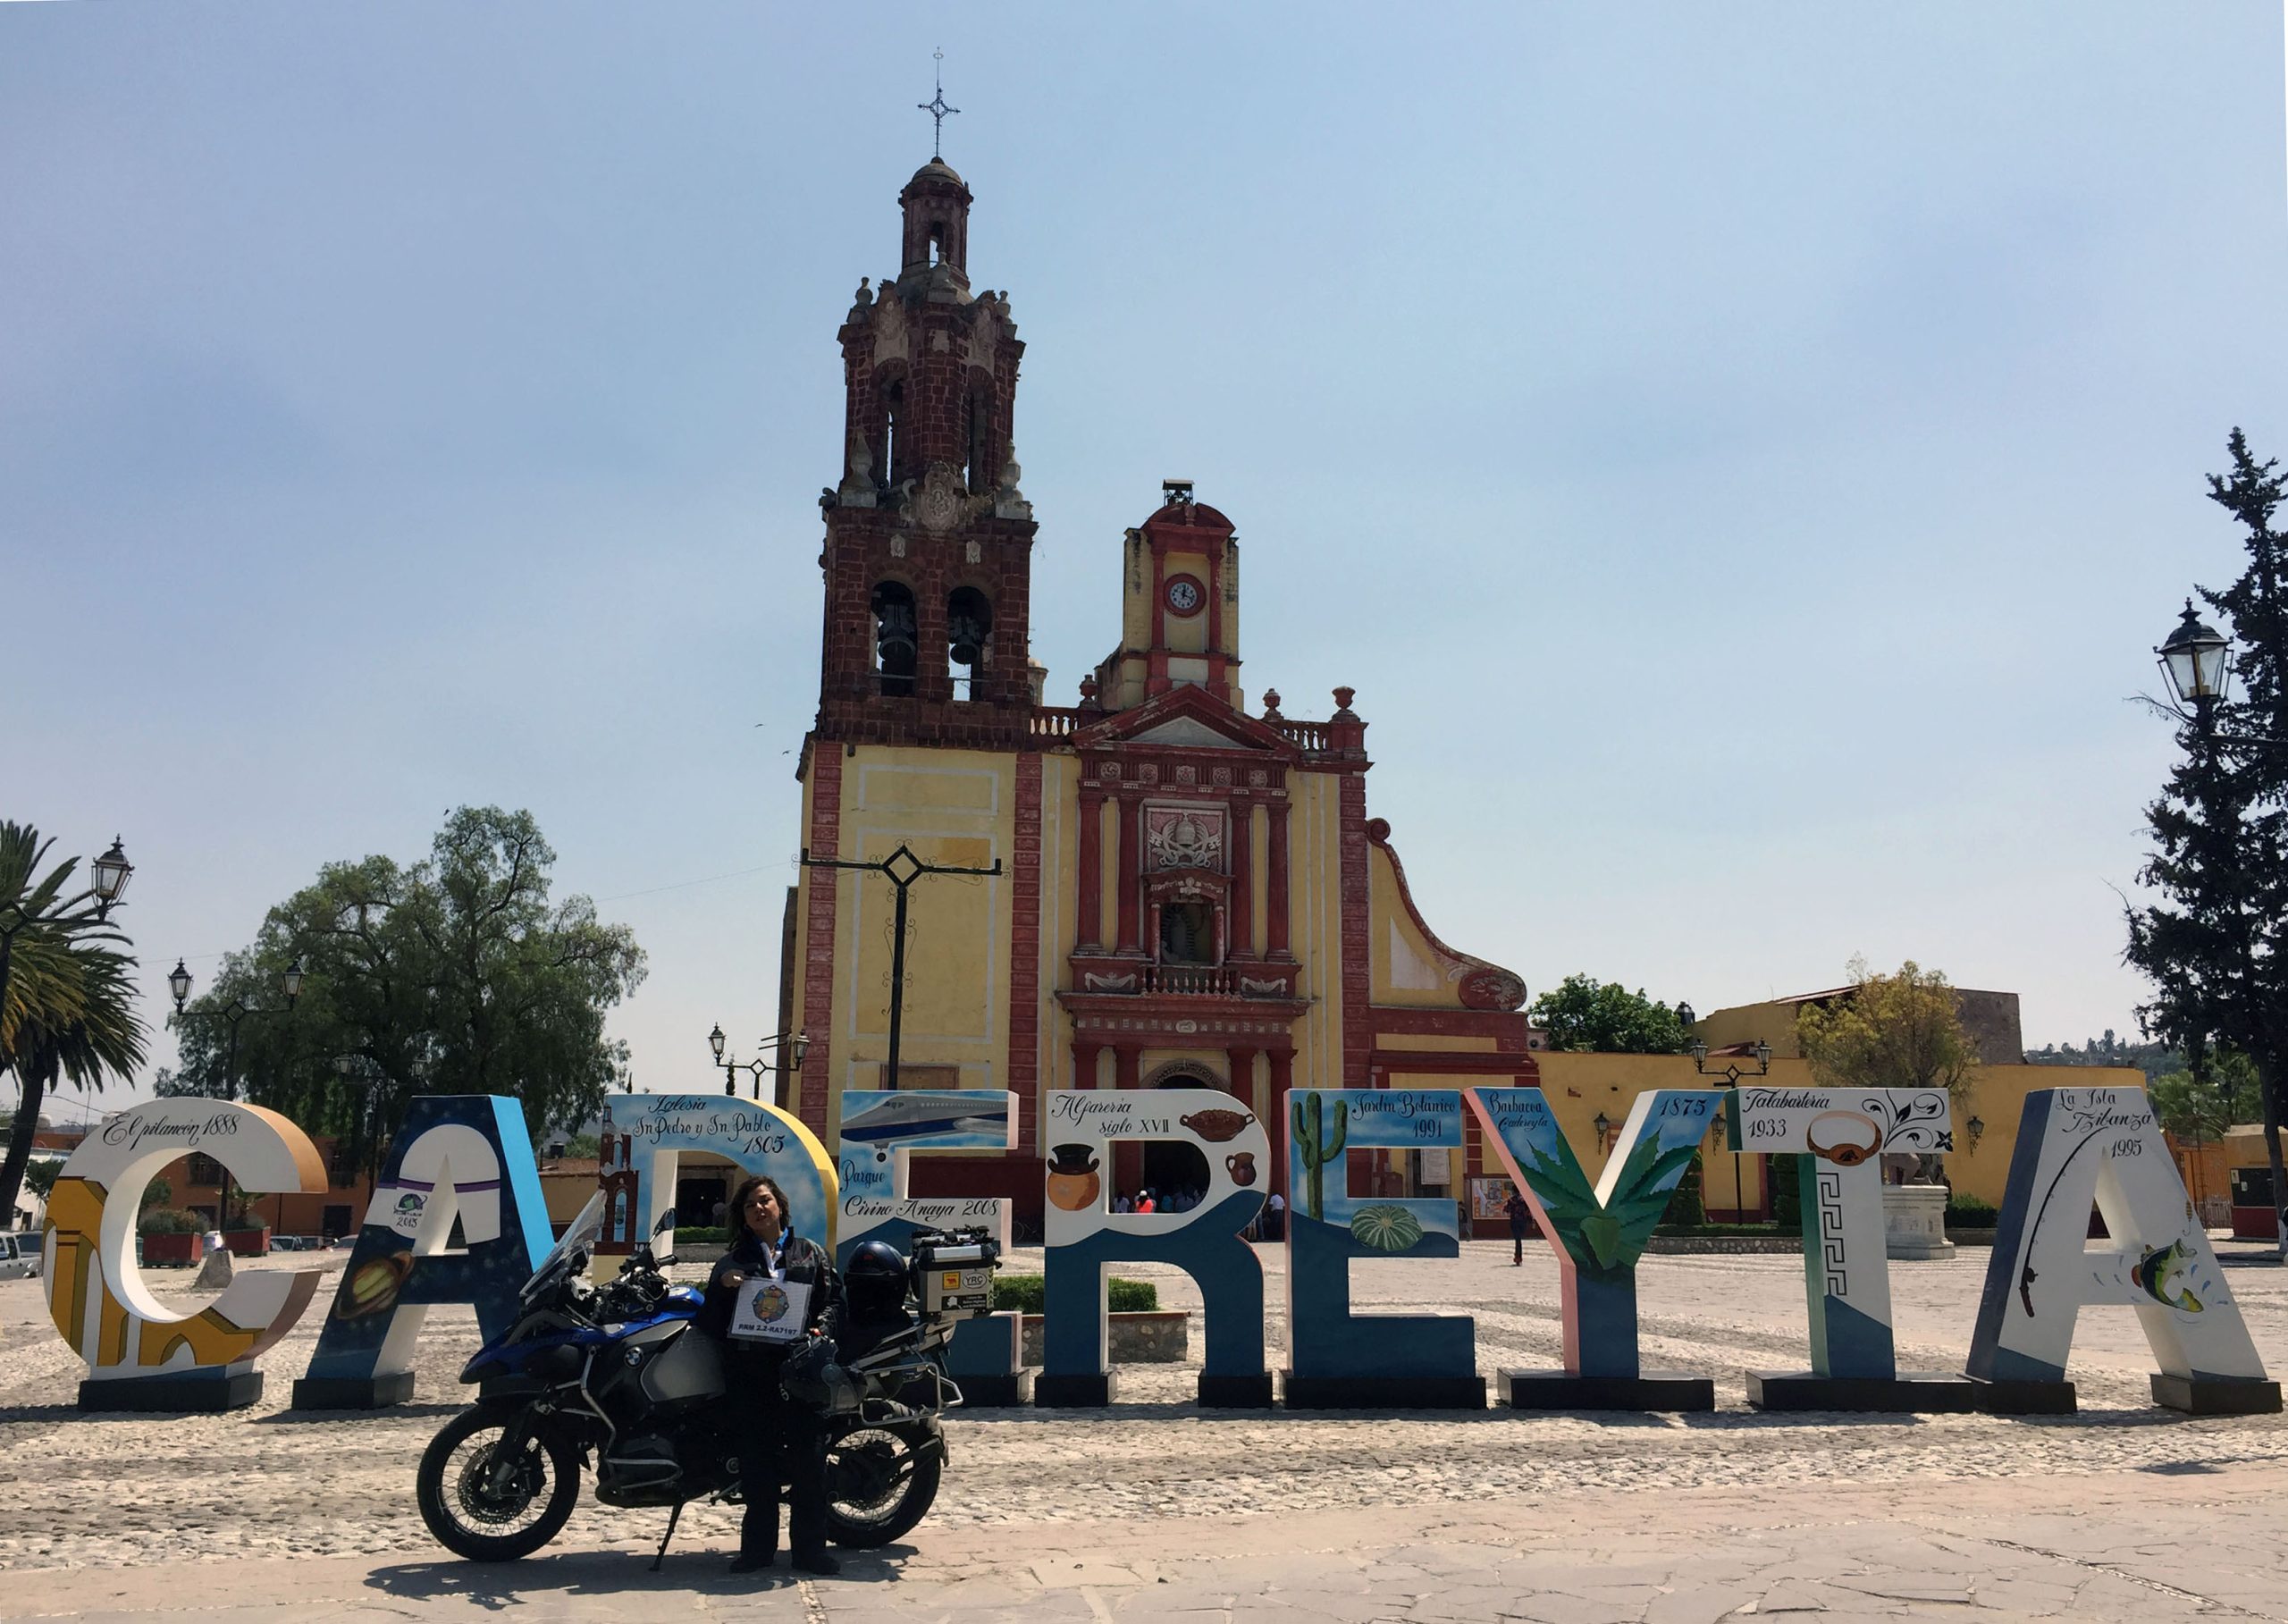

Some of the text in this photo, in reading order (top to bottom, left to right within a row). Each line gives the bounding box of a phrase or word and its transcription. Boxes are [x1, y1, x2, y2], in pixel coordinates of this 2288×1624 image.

[648, 1095, 706, 1115] Iglesia
[1487, 1090, 1543, 1115] Barbacoa
[1660, 1098, 1708, 1116] 1875
[2056, 1089, 2116, 1111] La Isla
[103, 1112, 143, 1146] El
[202, 1114, 241, 1135] 1888
[651, 1116, 691, 1145] Pedro
[689, 1123, 702, 1140] y
[728, 1113, 771, 1142] Pablo
[1099, 1117, 1170, 1137] siglo XVII
[1413, 1119, 1442, 1139] 1991
[1748, 1118, 1787, 1138] 1933
[743, 1134, 786, 1154] 1805
[2111, 1138, 2142, 1158] 1995
[839, 1159, 885, 1192] Parque
[845, 1195, 1001, 1223] Cirino Anaya 2008
[965, 1275, 983, 1283] YRC
